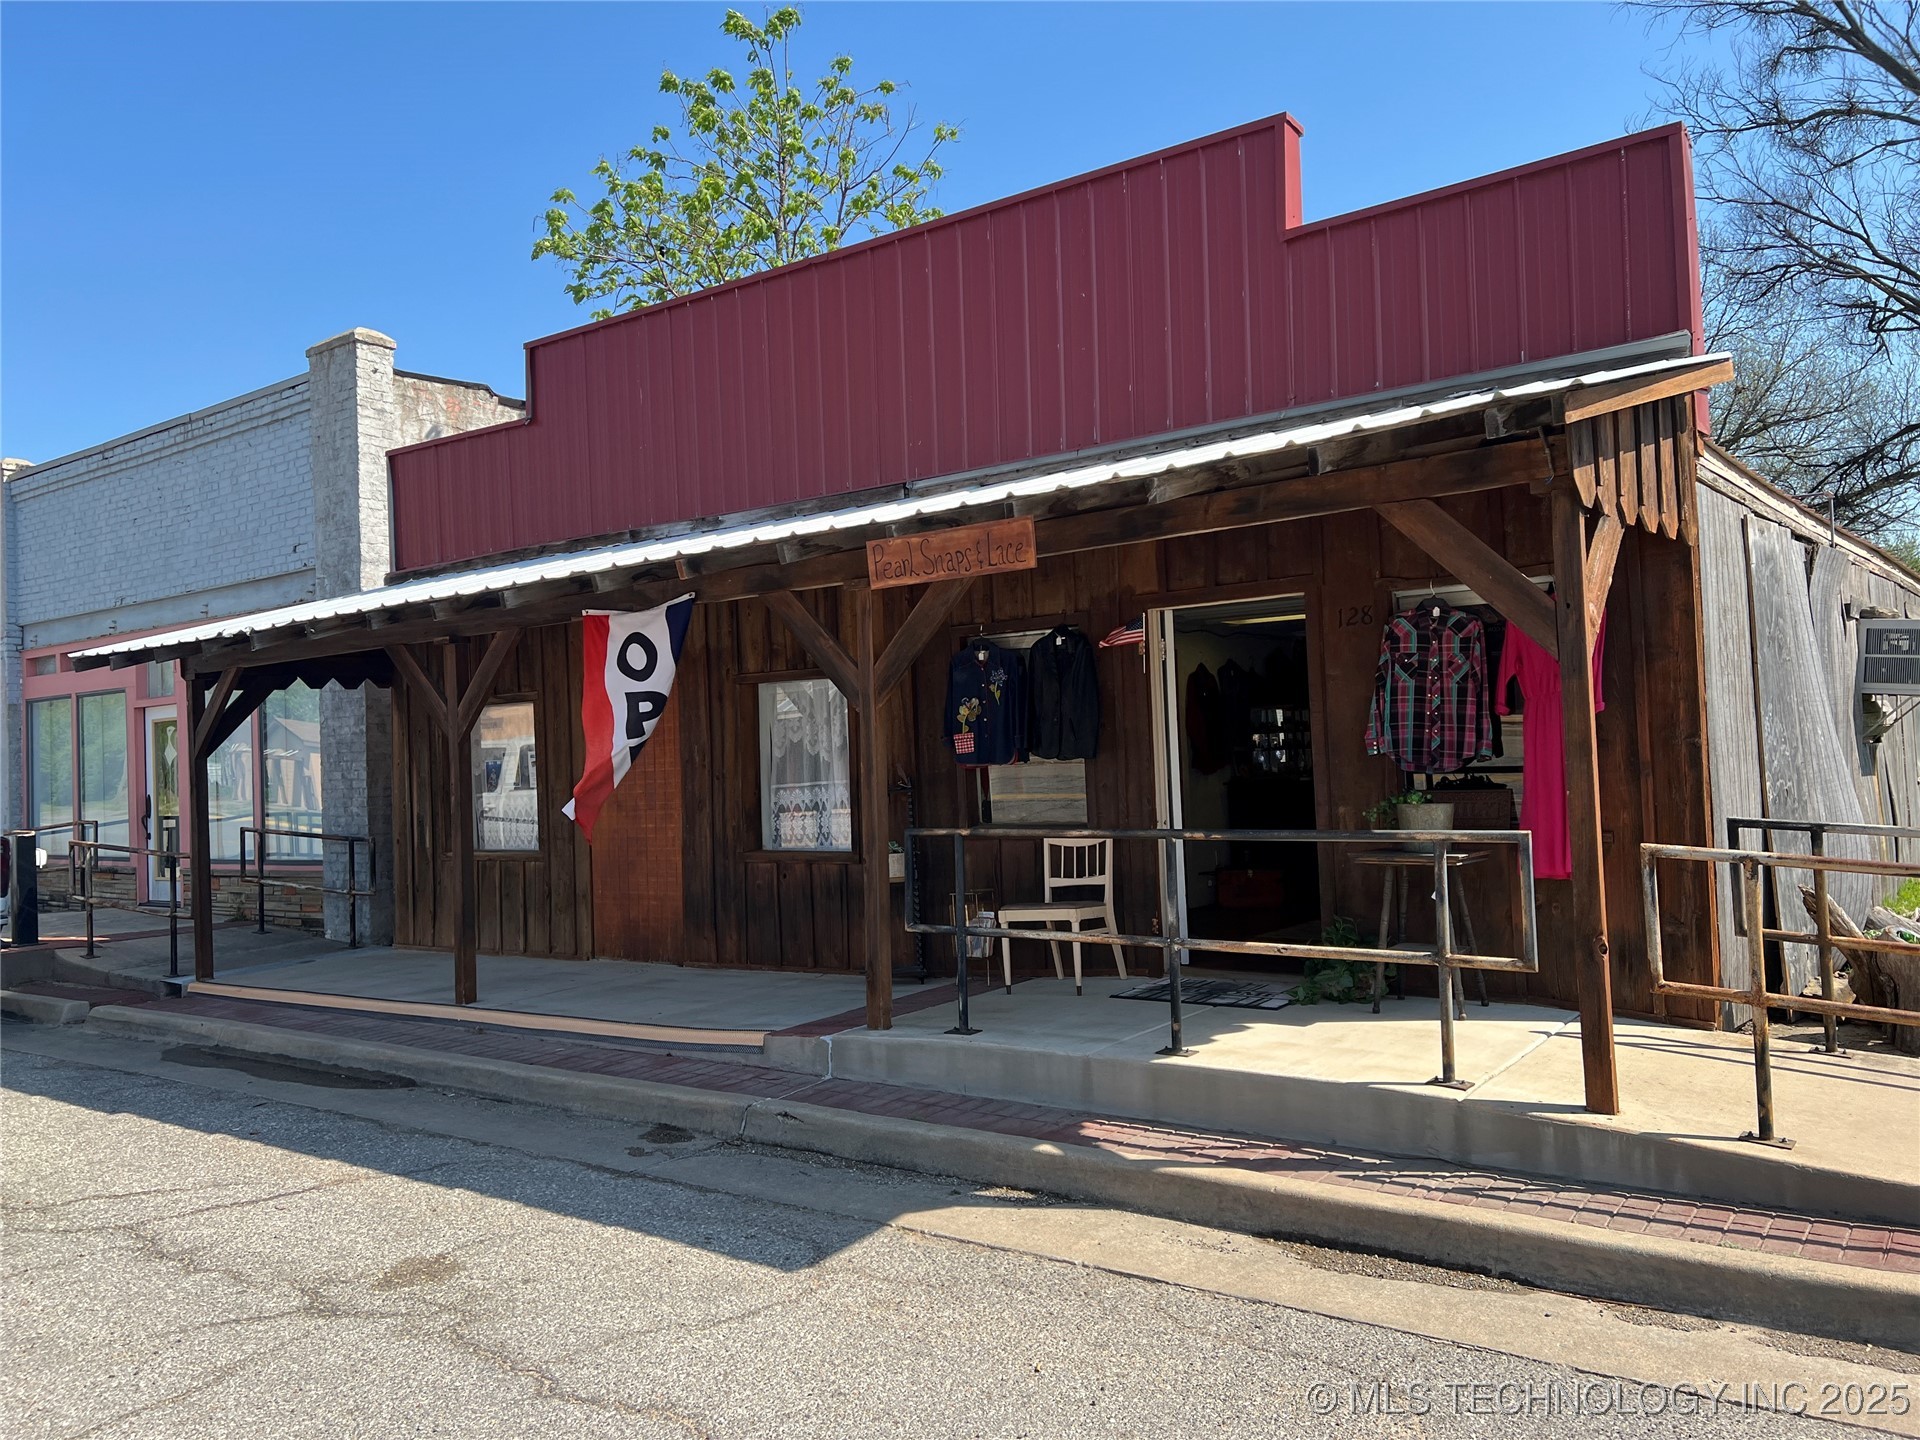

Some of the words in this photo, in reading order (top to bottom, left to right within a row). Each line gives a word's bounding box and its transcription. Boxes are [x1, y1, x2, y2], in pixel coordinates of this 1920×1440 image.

[872, 541, 920, 581] Pearl
[920, 538, 972, 575] Snaps
[986, 532, 1027, 567] Lace
[1338, 605, 1373, 629] 128
[616, 631, 670, 766] OP
